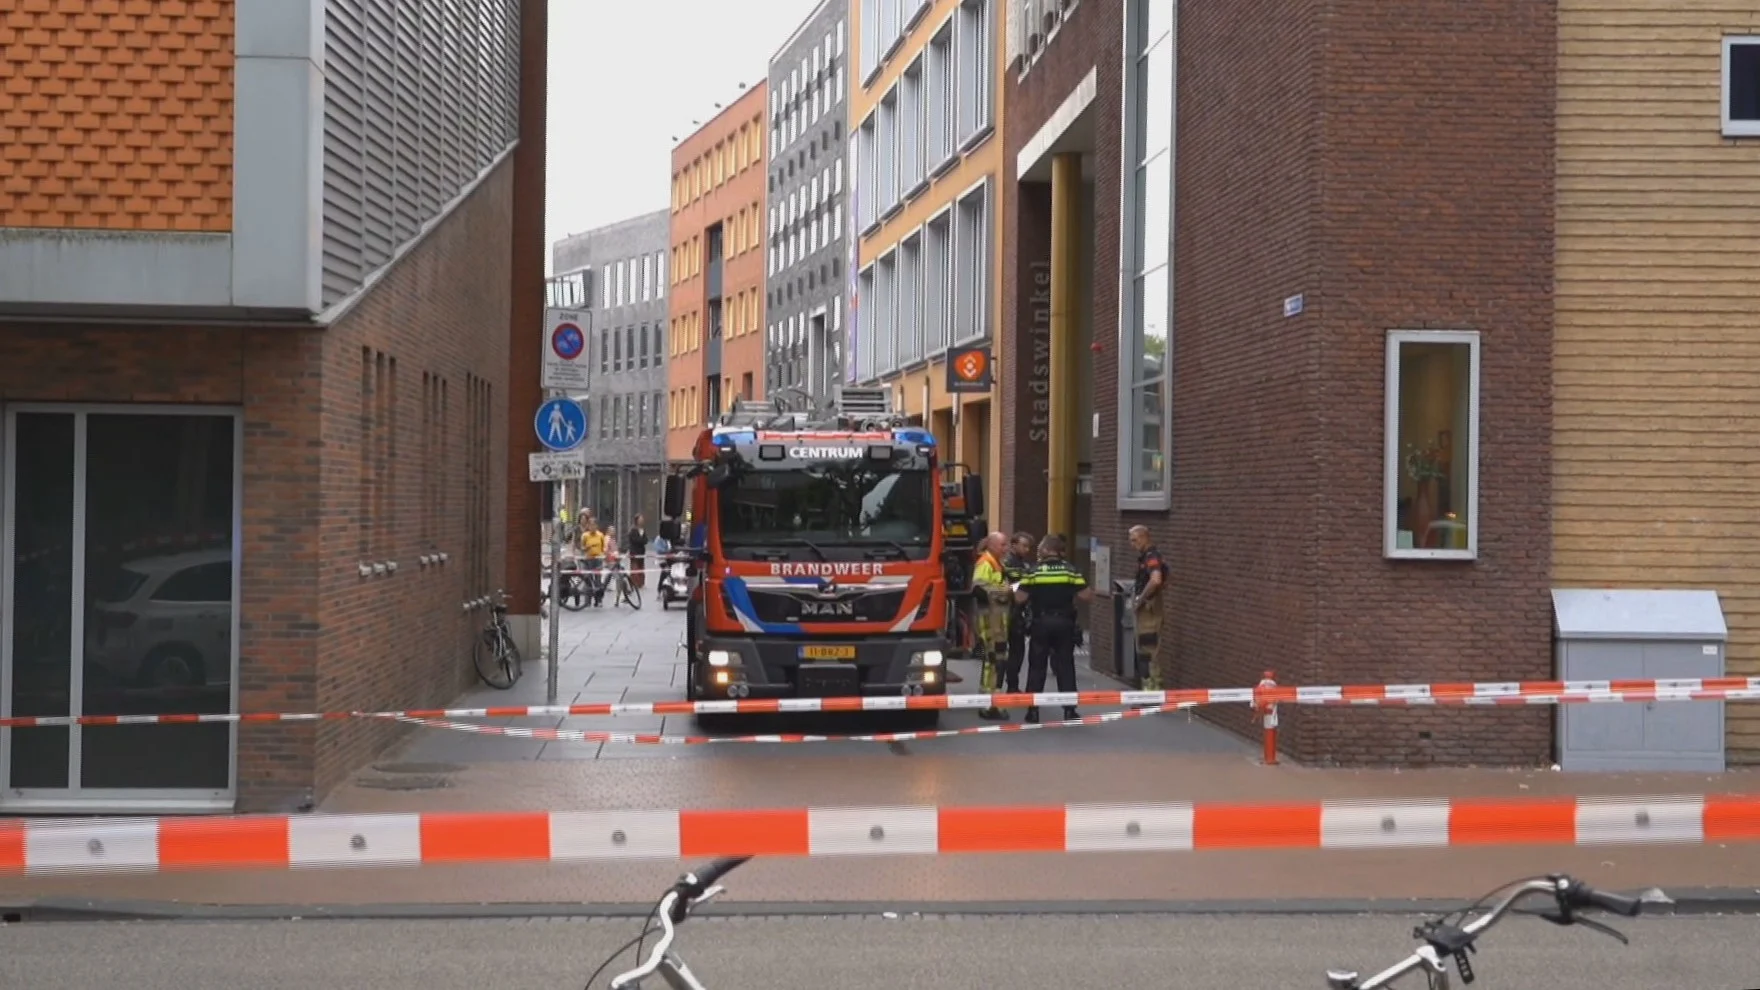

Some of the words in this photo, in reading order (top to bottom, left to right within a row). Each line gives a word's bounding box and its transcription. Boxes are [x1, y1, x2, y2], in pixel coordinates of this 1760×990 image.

[1029, 261, 1050, 442] Stadswinkel
[789, 446, 864, 459] CENTRUM
[770, 563, 883, 576] BRANDWEER
[801, 601, 853, 615] MAN
